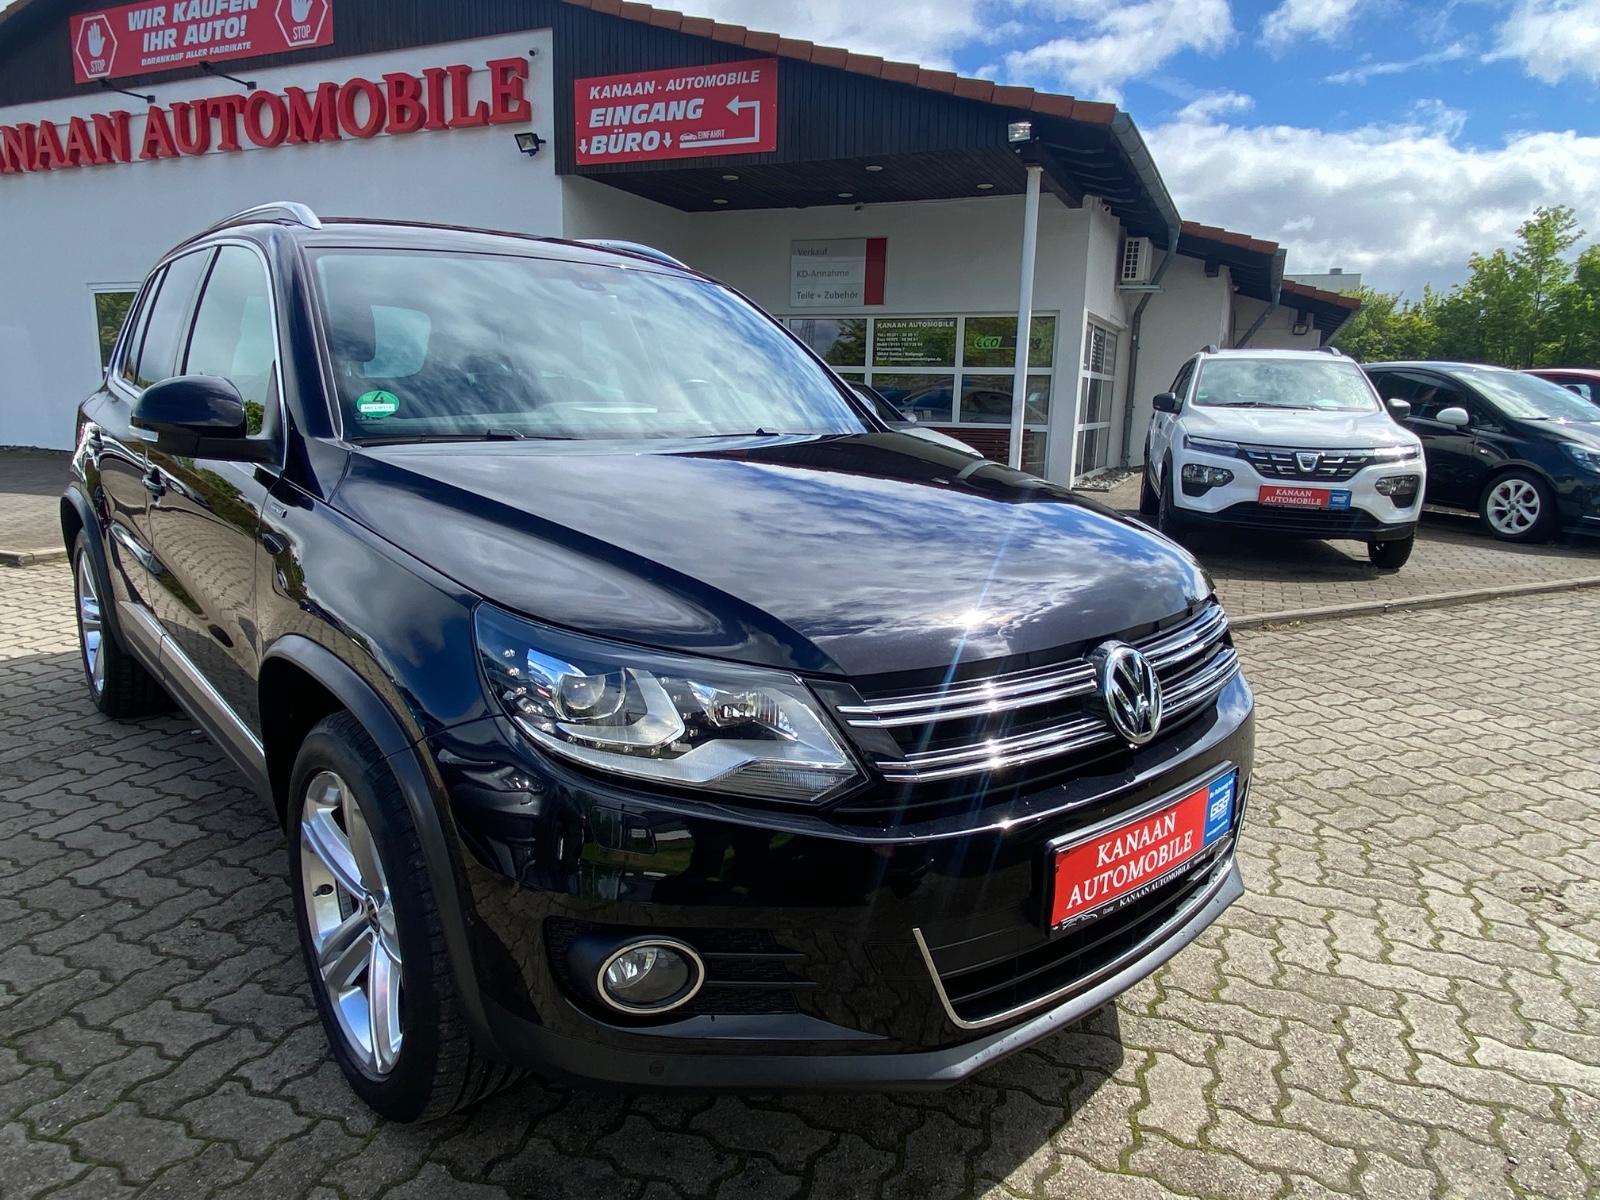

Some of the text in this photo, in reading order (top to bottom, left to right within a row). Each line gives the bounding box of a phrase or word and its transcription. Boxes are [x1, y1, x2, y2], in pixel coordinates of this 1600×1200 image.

[128, 6, 166, 31] WIR
[143, 15, 247, 52] IHR AUTO!
[292, 25, 312, 41] STOP
[186, 48, 208, 59] ALLER
[209, 41, 252, 55] FABRIKATE
[90, 60, 106, 74] STOP
[589, 80, 656, 100] KANAAN
[665, 70, 760, 92] AUTOMOBILE
[0, 57, 532, 173] NAAN AUTOMOBILE
[588, 98, 705, 128] EINGANG
[590, 128, 660, 155] BÜRO
[697, 129, 725, 140] EINFAHRT
[797, 247, 828, 256] Verkauf
[796, 269, 850, 279] KD-Annahme
[797, 291, 815, 300] Teile
[824, 290, 859, 299] Zubehör
[877, 320, 955, 329] KANAAN AUTOMOBILE
[372, 391, 385, 404] 4
[1264, 496, 1322, 505] AUTOMOBILE
[1276, 488, 1312, 497] KANAAN
[1096, 811, 1177, 868] KANAAN
[1065, 830, 1193, 909] AUTOMOBILE
[1119, 863, 1192, 907] KANAAN AUTOMOBILE
